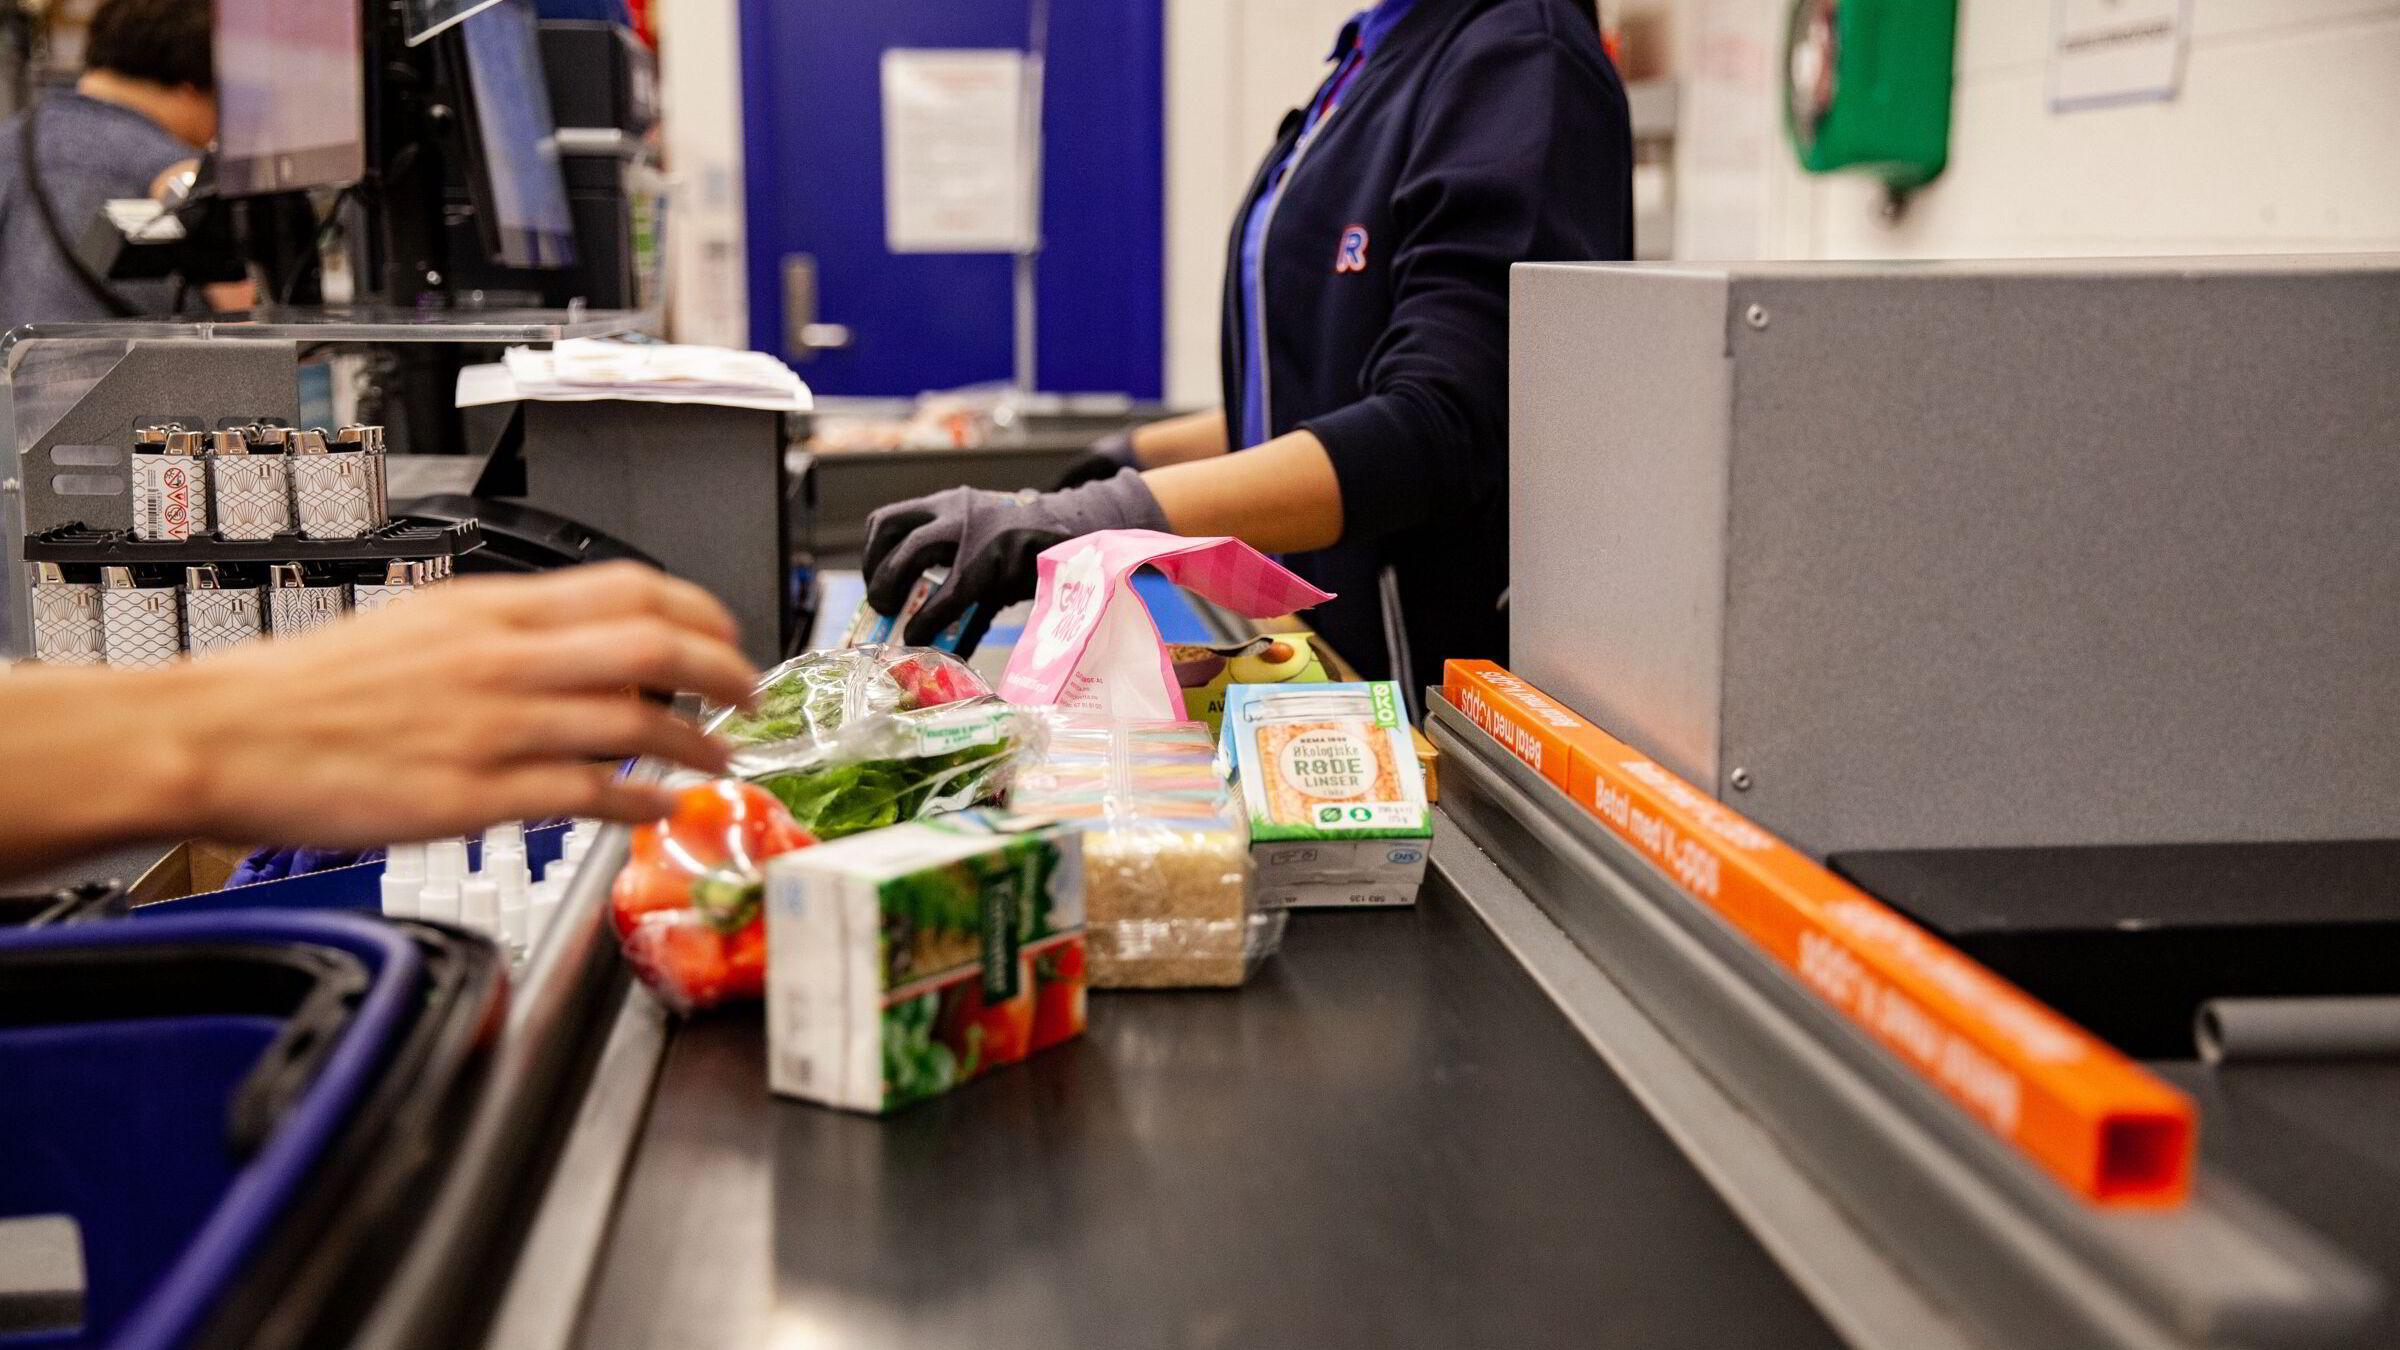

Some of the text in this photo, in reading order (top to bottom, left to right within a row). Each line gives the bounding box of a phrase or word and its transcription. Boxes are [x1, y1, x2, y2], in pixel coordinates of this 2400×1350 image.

[1336, 225, 1368, 272] R
[1207, 701, 1225, 714] AV
[1372, 683, 1395, 721] ØKO
[1493, 710, 1514, 745] med
[1515, 725, 1541, 770] Betal
[1294, 758, 1363, 776] RØDE
[1304, 776, 1359, 787] LINSER
